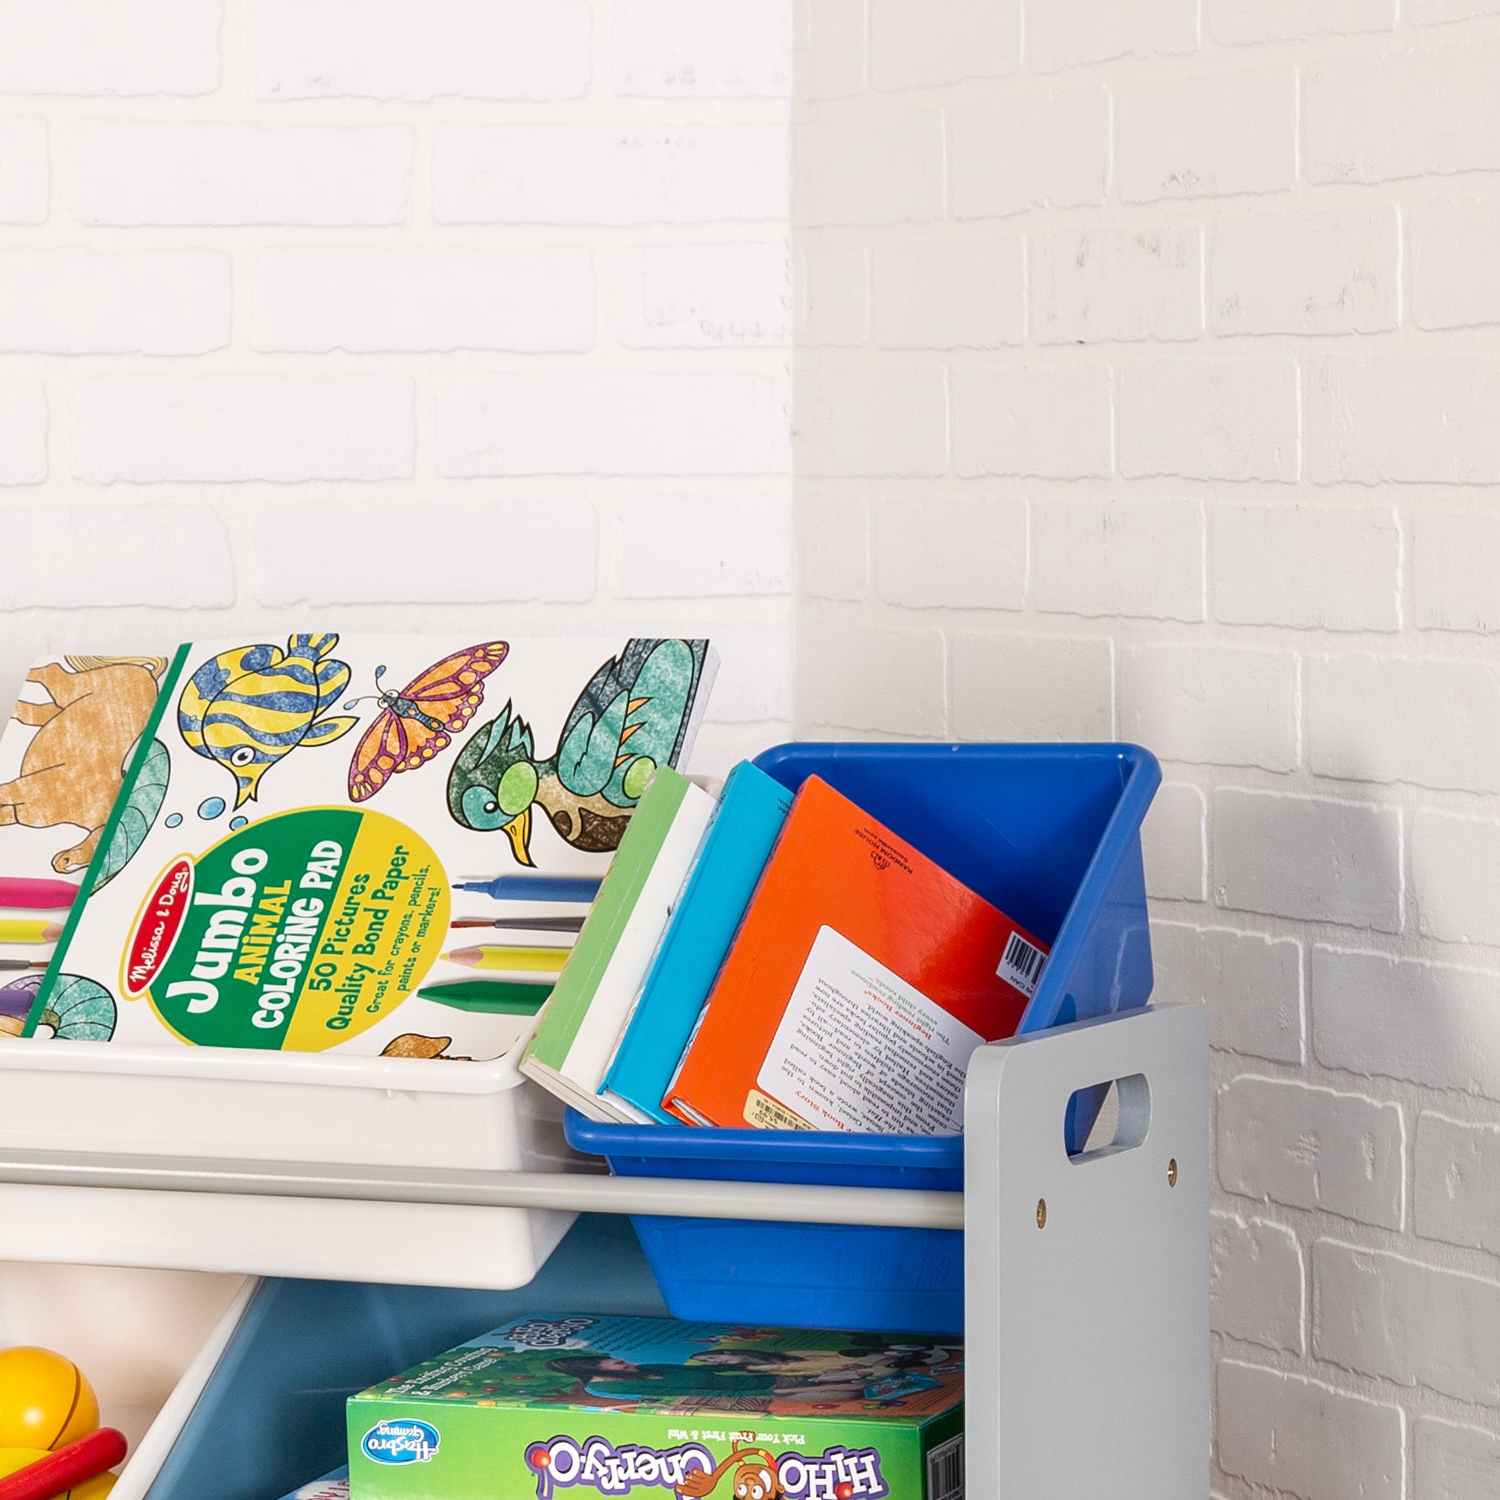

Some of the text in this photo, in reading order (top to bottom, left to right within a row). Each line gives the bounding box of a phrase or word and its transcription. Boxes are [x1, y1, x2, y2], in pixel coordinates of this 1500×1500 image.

[299, 840, 342, 889] PAD
[165, 848, 268, 1013] Jumbo
[308, 865, 370, 991] 50 Pictures
[326, 845, 410, 1030] Quality Bond Paper
[397, 887, 441, 992] paints or markers!
[129, 921, 165, 982] Melissa
[377, 959, 395, 976] for
[366, 980, 389, 1013] Great
[895, 1011, 932, 1040] Beginner
[366, 1435, 437, 1461] Hasbro
[690, 1430, 698, 1440] &
[701, 1430, 725, 1440] First
[728, 1431, 753, 1442] Fruit
[755, 1433, 780, 1444] Your
[782, 1434, 805, 1445] Pick
